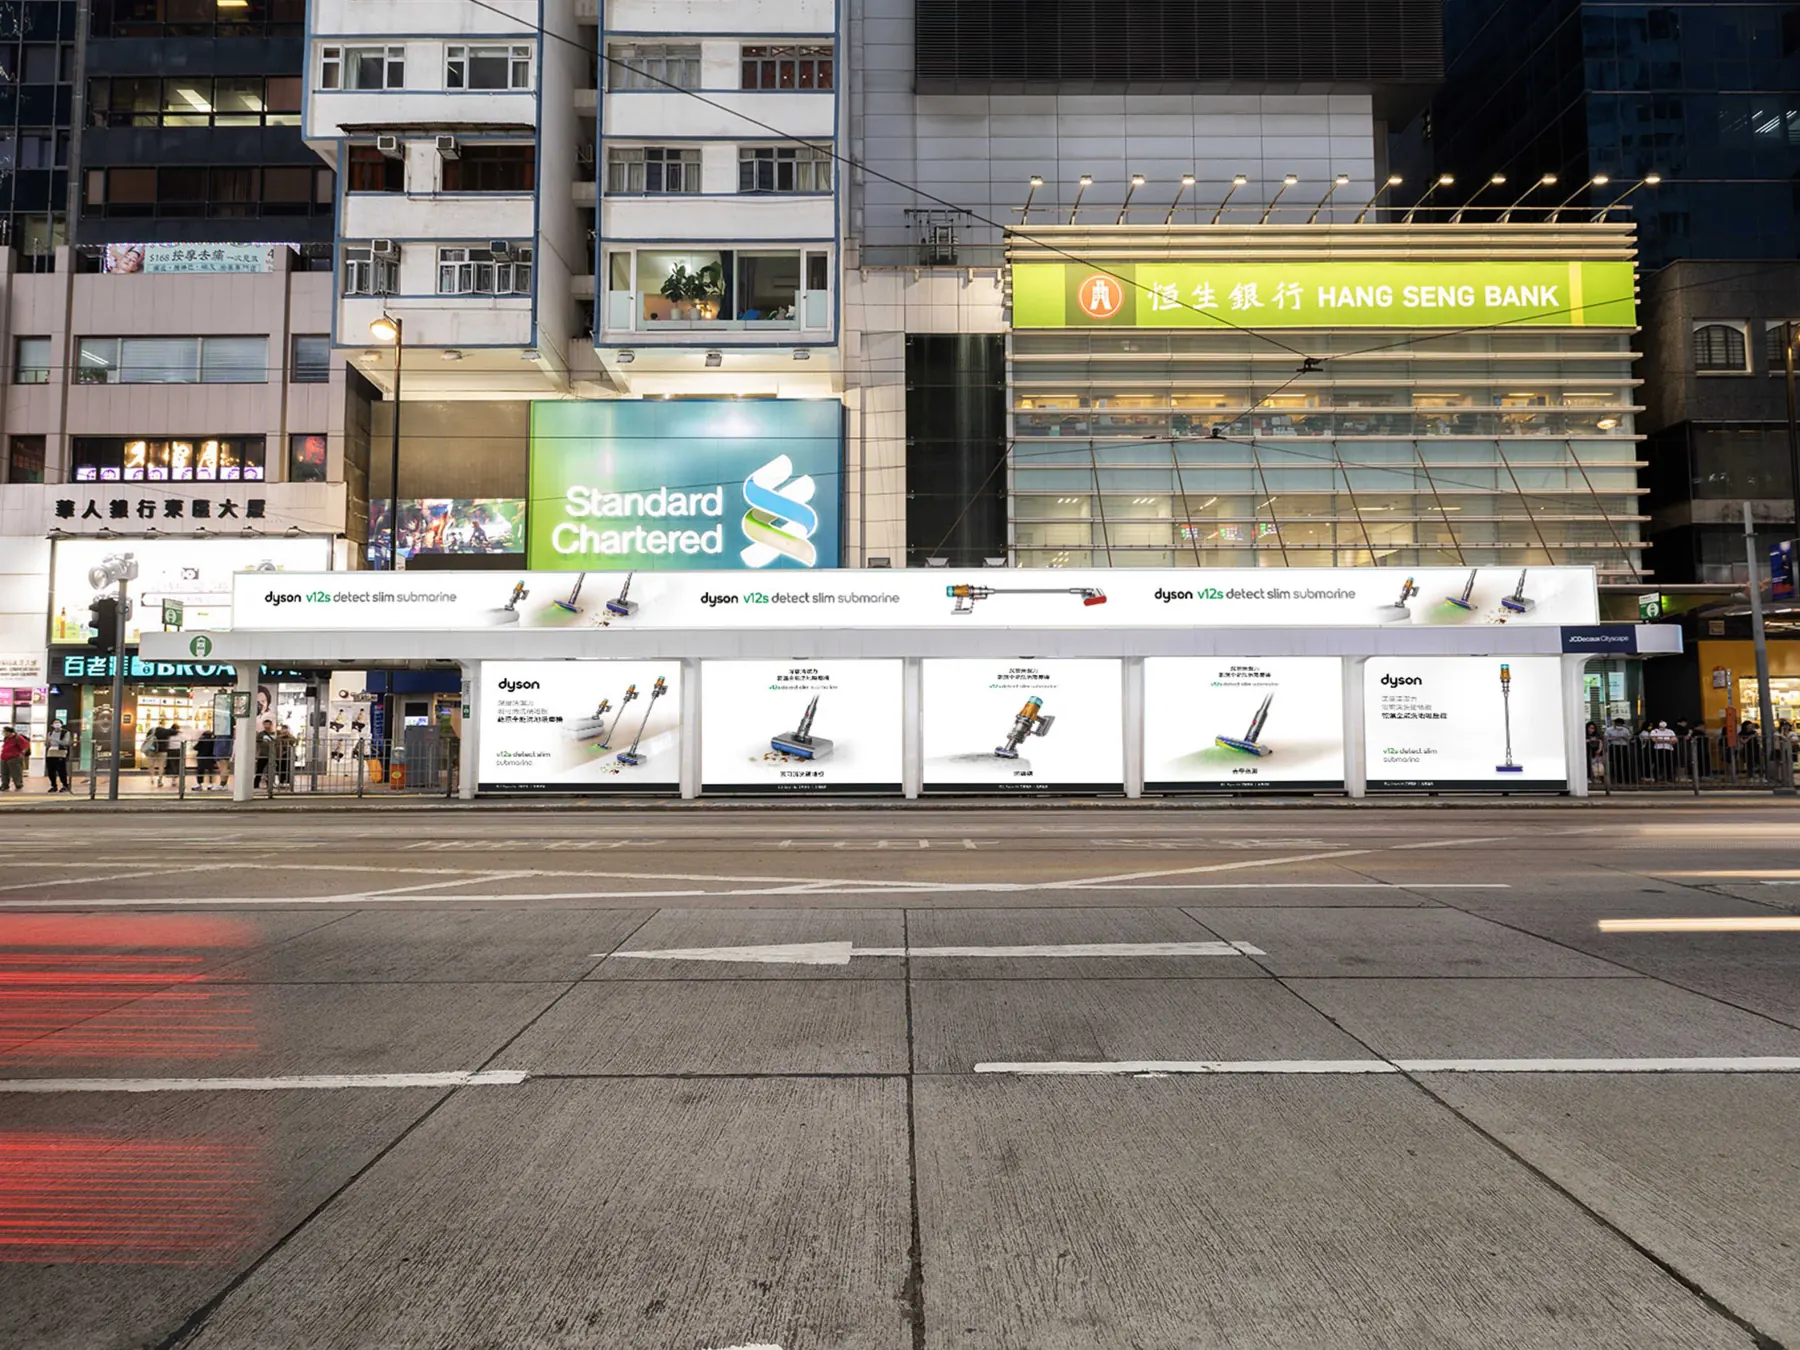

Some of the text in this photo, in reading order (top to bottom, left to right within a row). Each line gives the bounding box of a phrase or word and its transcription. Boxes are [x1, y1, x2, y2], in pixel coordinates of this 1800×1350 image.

[1147, 281, 1559, 311] 恒生銀行 HANG SENG BANK
[565, 485, 723, 517] Standard
[551, 523, 723, 555] Chartered
[265, 590, 457, 606] dyson v12s detect slim submarine
[700, 591, 900, 607] dyson v12s detect slim submarine
[1154, 587, 1356, 603] dyson v12s detect slim submarine
[1600, 635, 1629, 643] Cityscape
[498, 677, 540, 692] dyson
[1380, 673, 1422, 688] dyson
